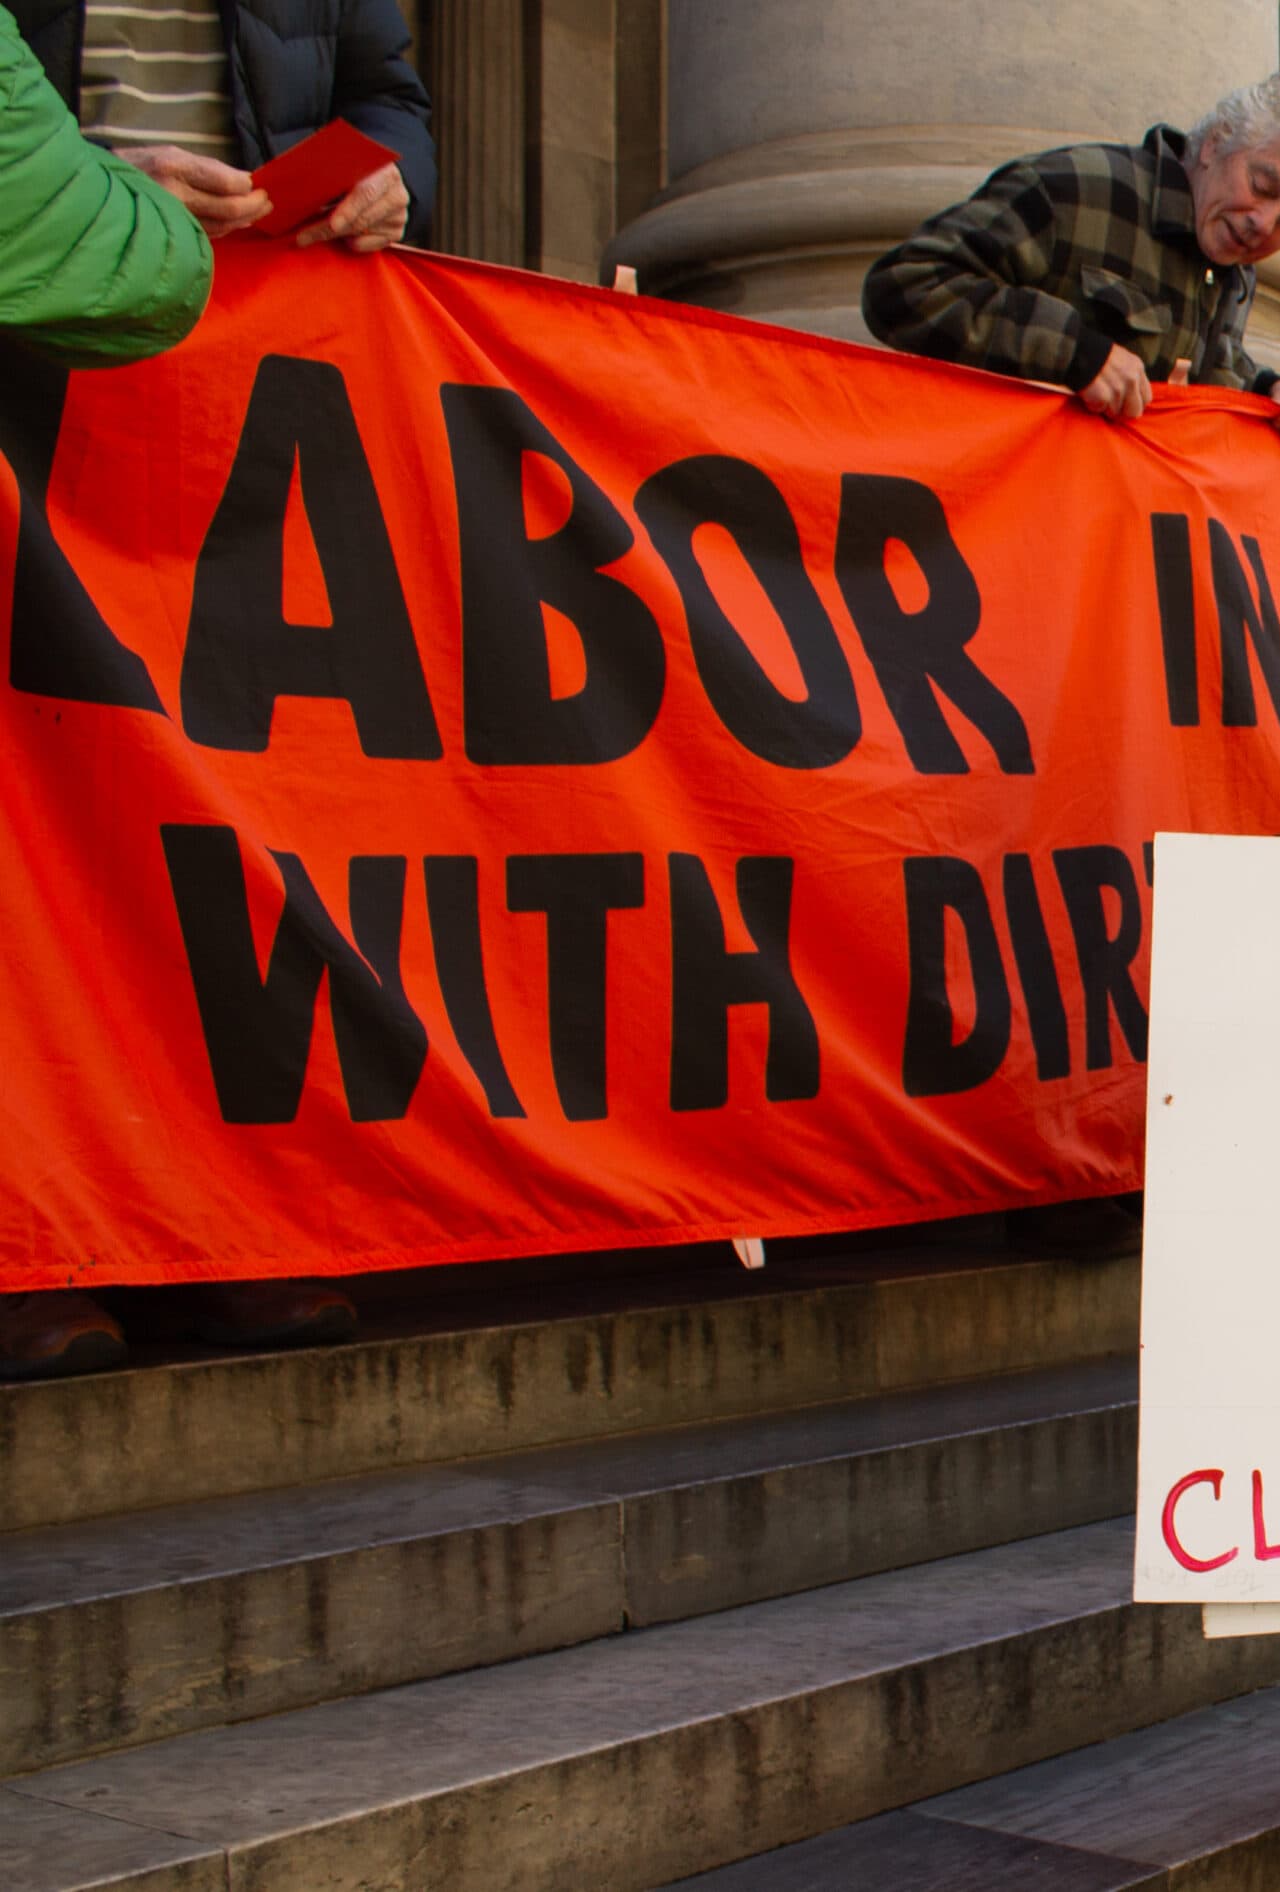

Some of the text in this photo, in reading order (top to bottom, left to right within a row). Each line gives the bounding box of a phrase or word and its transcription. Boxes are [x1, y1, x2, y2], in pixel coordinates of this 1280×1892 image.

[0, 332, 1035, 775] LABOR
[159, 823, 1154, 1125] WITH DIR
